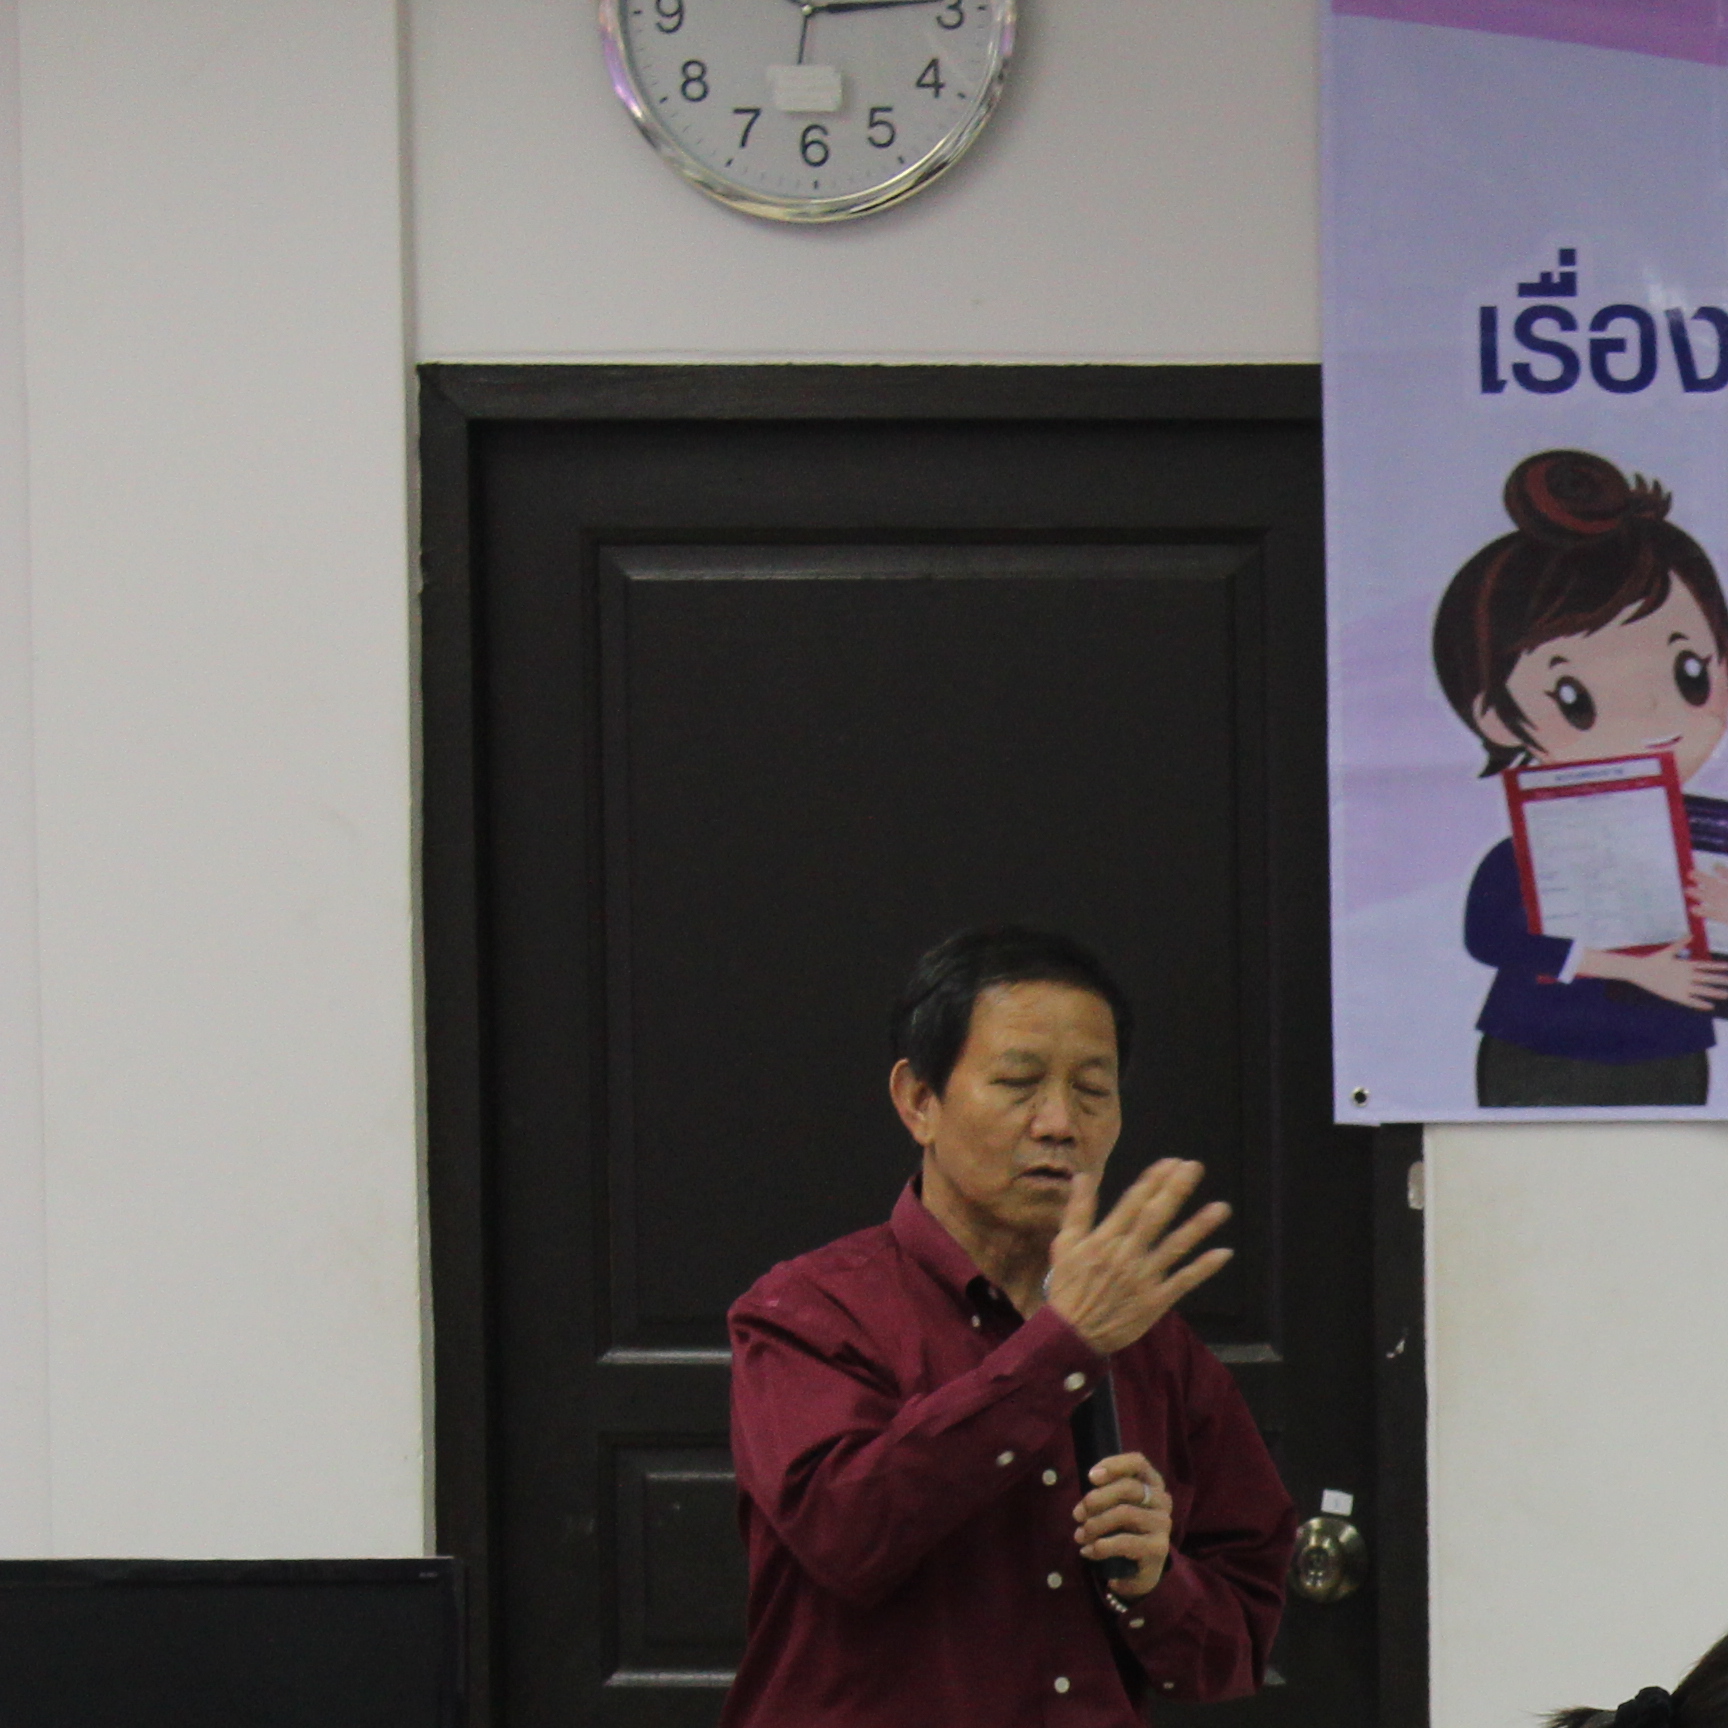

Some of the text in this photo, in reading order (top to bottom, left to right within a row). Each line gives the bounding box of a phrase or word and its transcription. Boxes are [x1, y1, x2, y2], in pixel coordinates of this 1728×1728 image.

[681, 60, 708, 102] 8
[915, 58, 945, 98] 4
[733, 108, 762, 148] 7
[800, 124, 829, 167] 6
[867, 107, 895, 148] 5
